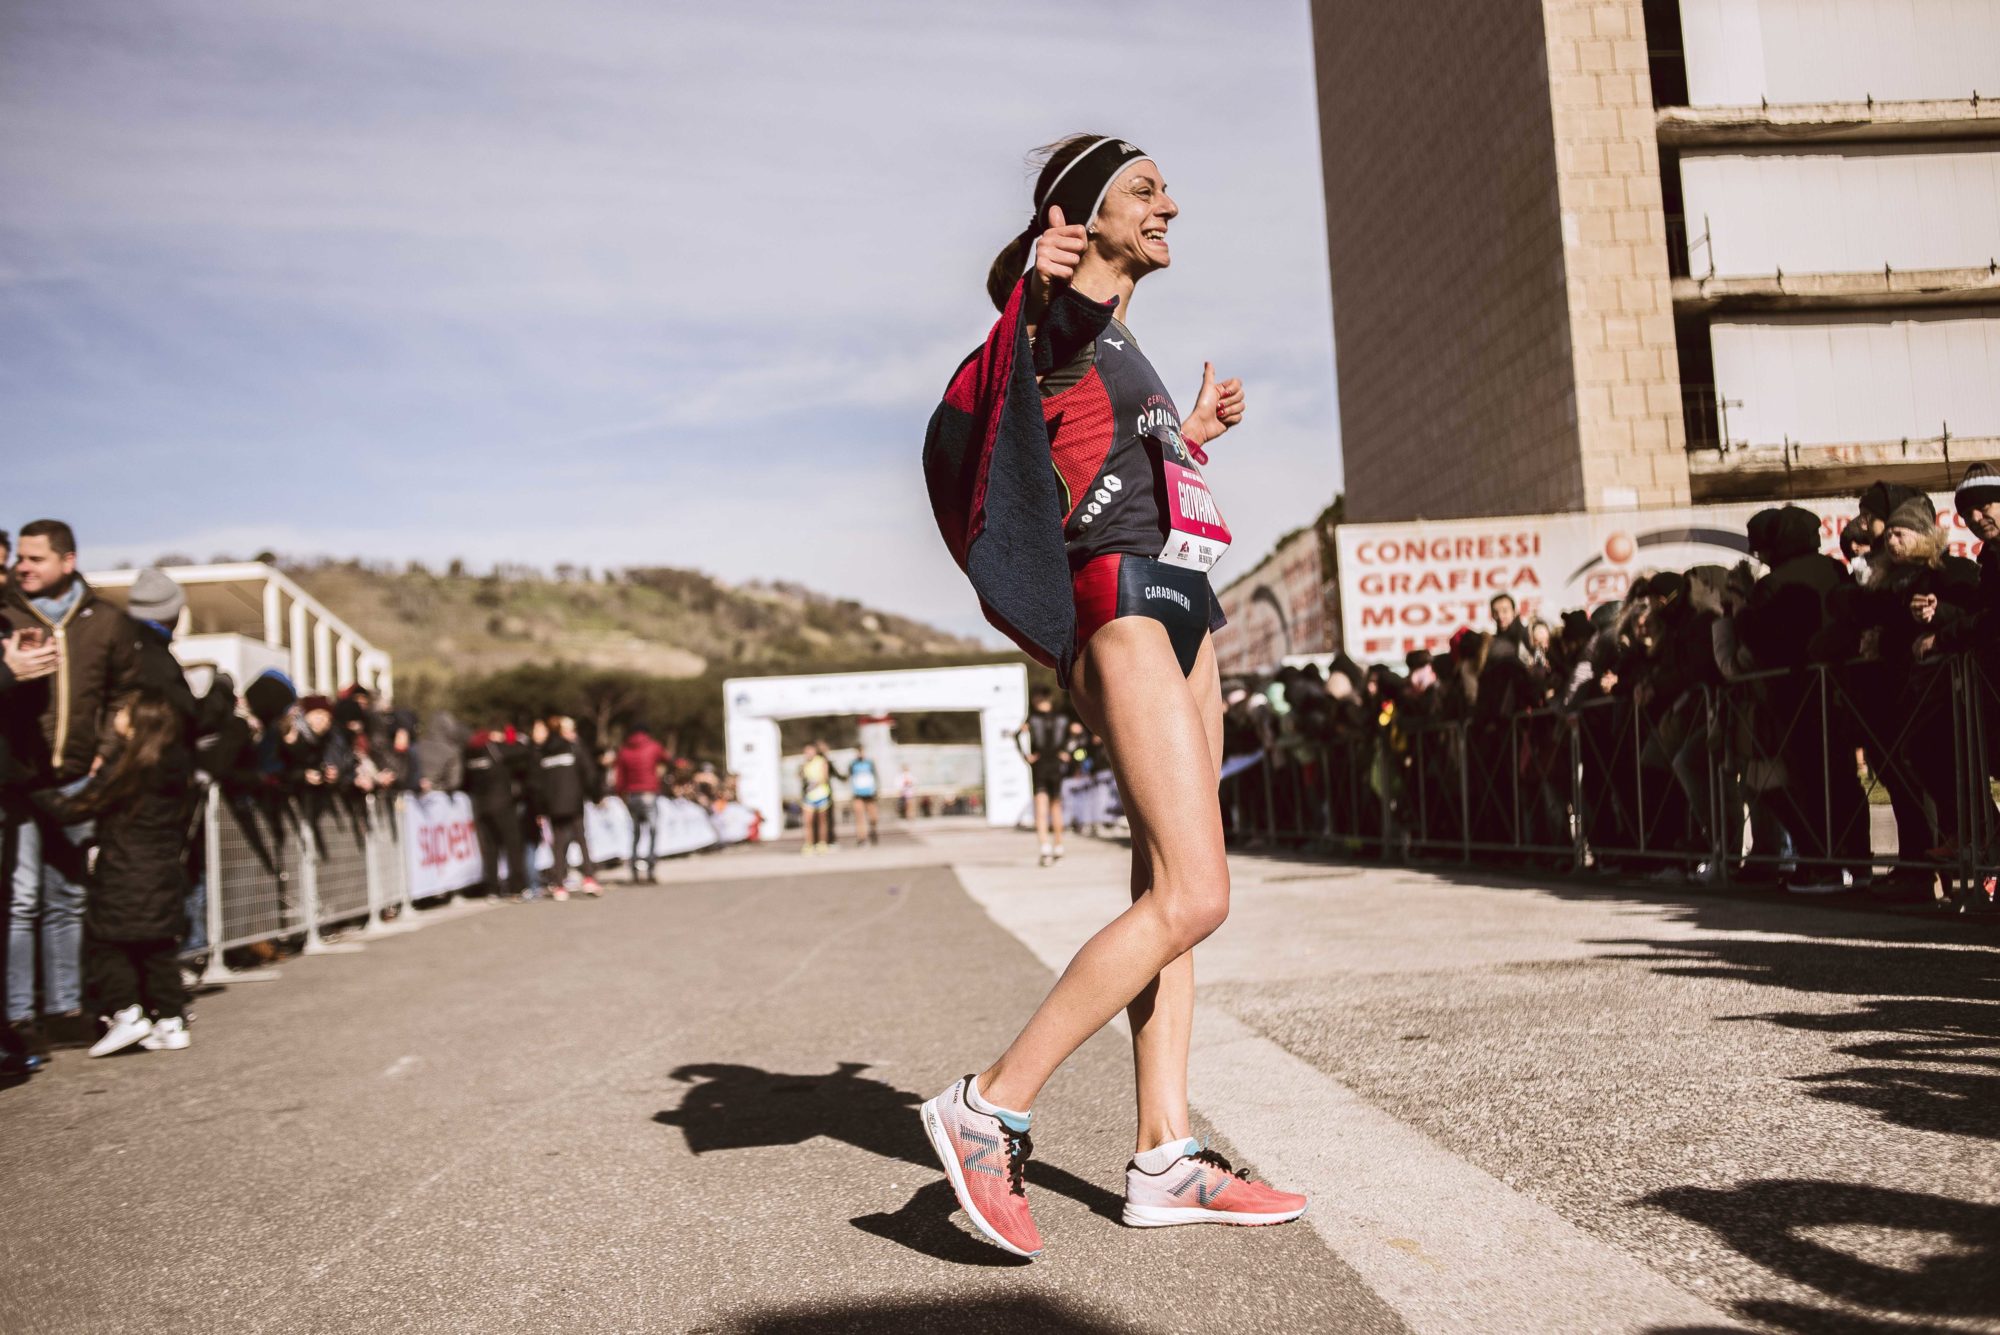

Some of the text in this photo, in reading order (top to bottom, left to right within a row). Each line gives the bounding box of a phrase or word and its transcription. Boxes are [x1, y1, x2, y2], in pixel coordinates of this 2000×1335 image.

[1356, 533, 1541, 564] CONGRESSI
[1358, 566, 1541, 595] GRAFICA
[1145, 585, 1191, 612] CARABINIERI
[1361, 599, 1543, 628] MOSTE
